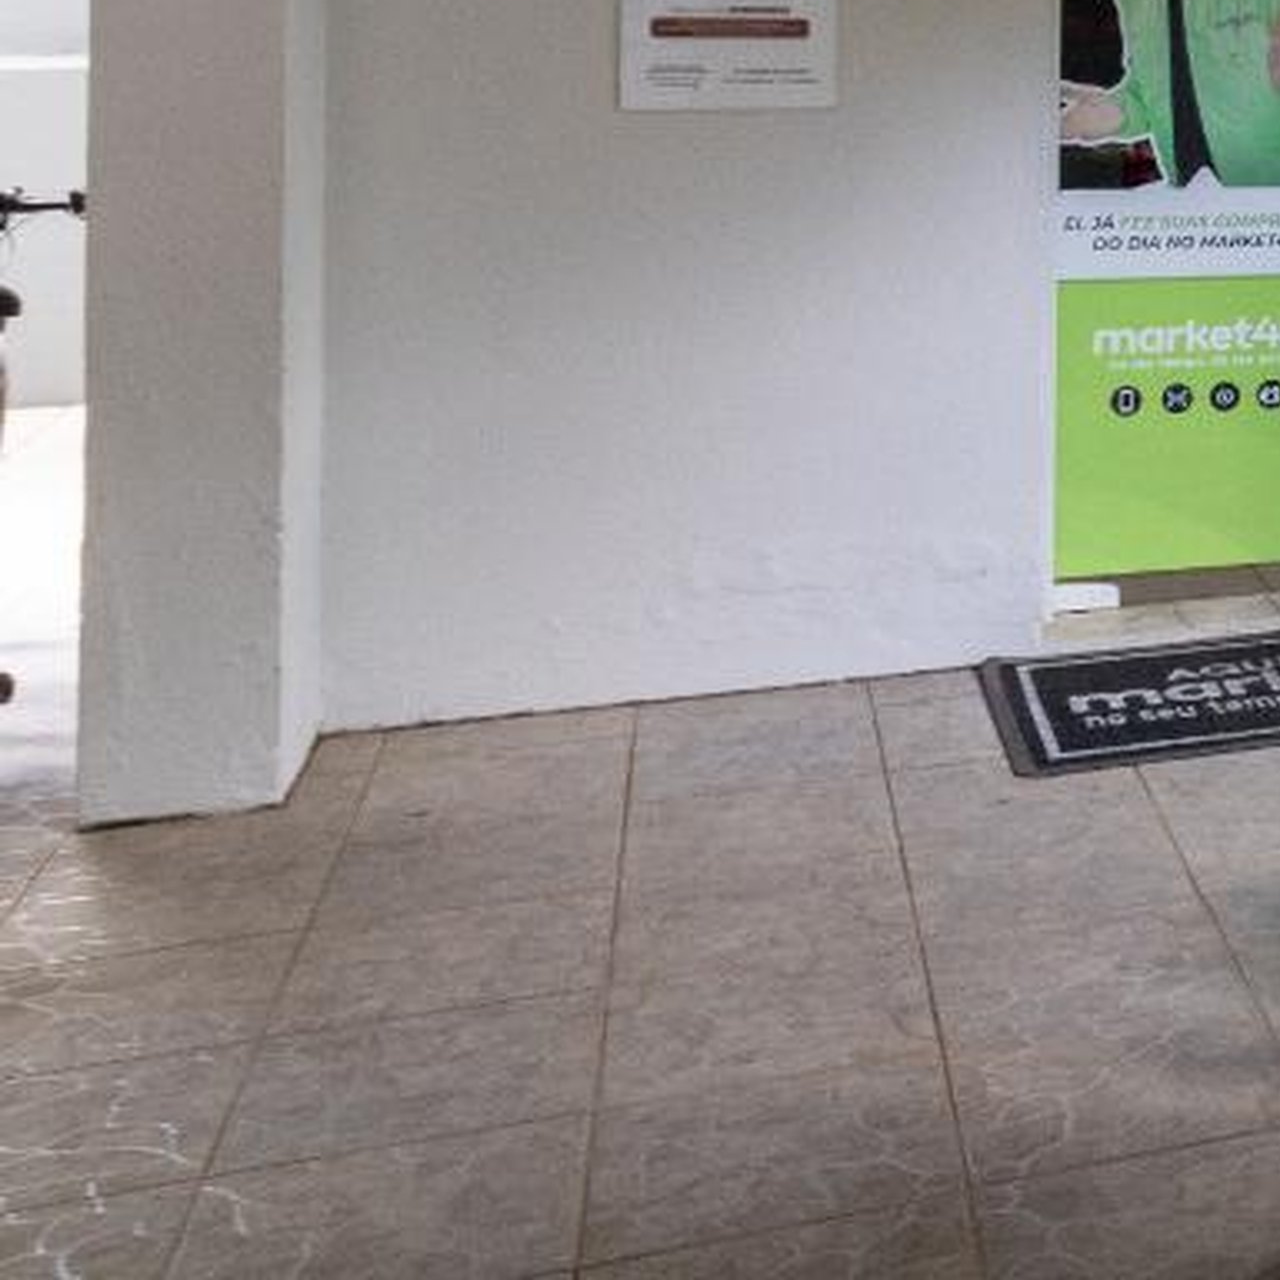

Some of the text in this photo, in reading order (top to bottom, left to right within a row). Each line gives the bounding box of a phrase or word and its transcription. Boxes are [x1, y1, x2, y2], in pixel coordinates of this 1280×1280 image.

[1093, 235, 1123, 251] DO
[1127, 235, 1160, 251] DIA
[1166, 235, 1195, 250] NO
